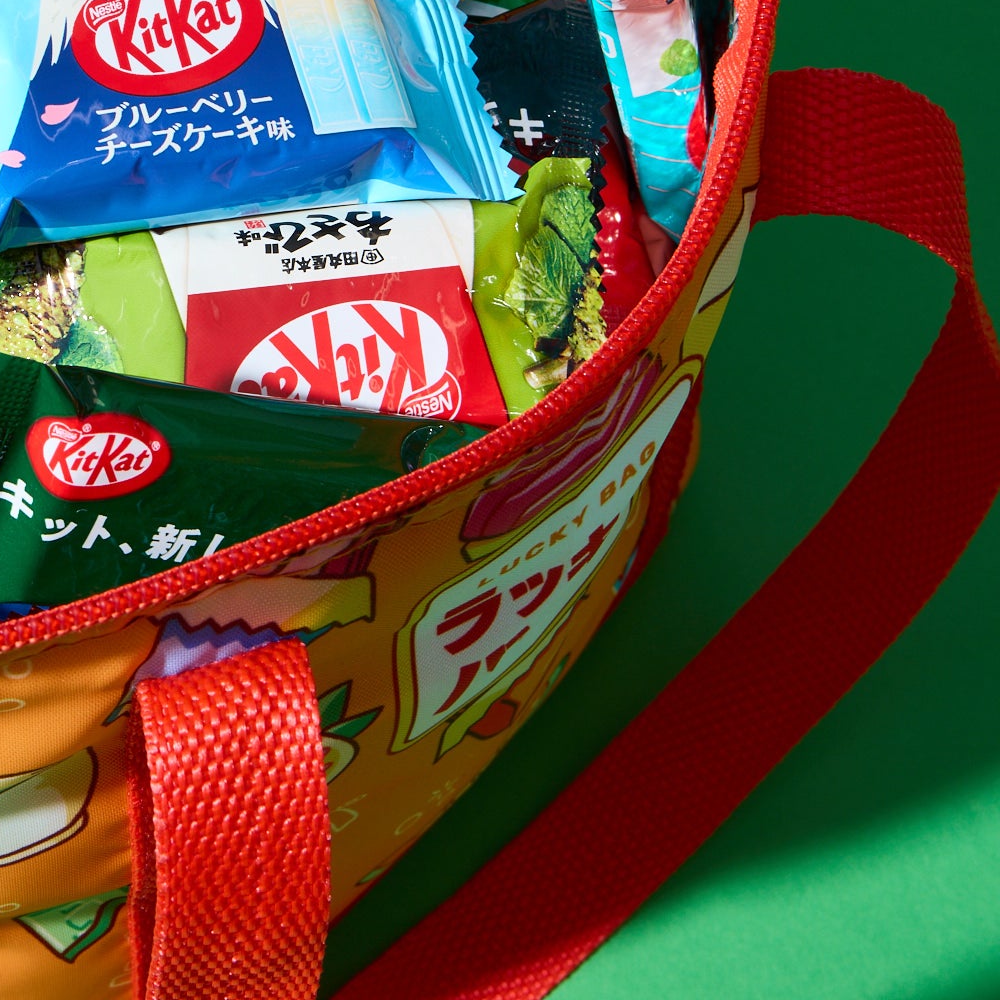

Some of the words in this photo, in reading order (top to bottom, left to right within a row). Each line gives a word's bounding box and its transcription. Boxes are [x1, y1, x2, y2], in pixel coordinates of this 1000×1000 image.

[95, 89, 274, 133] ブルーベリー
[95, 115, 297, 165] チーズケーキ味
[233, 211, 394, 255] わさび味
[50, 434, 150, 486] KitKat
[476, 504, 589, 590] LUCKY
[599, 440, 657, 506] BAG
